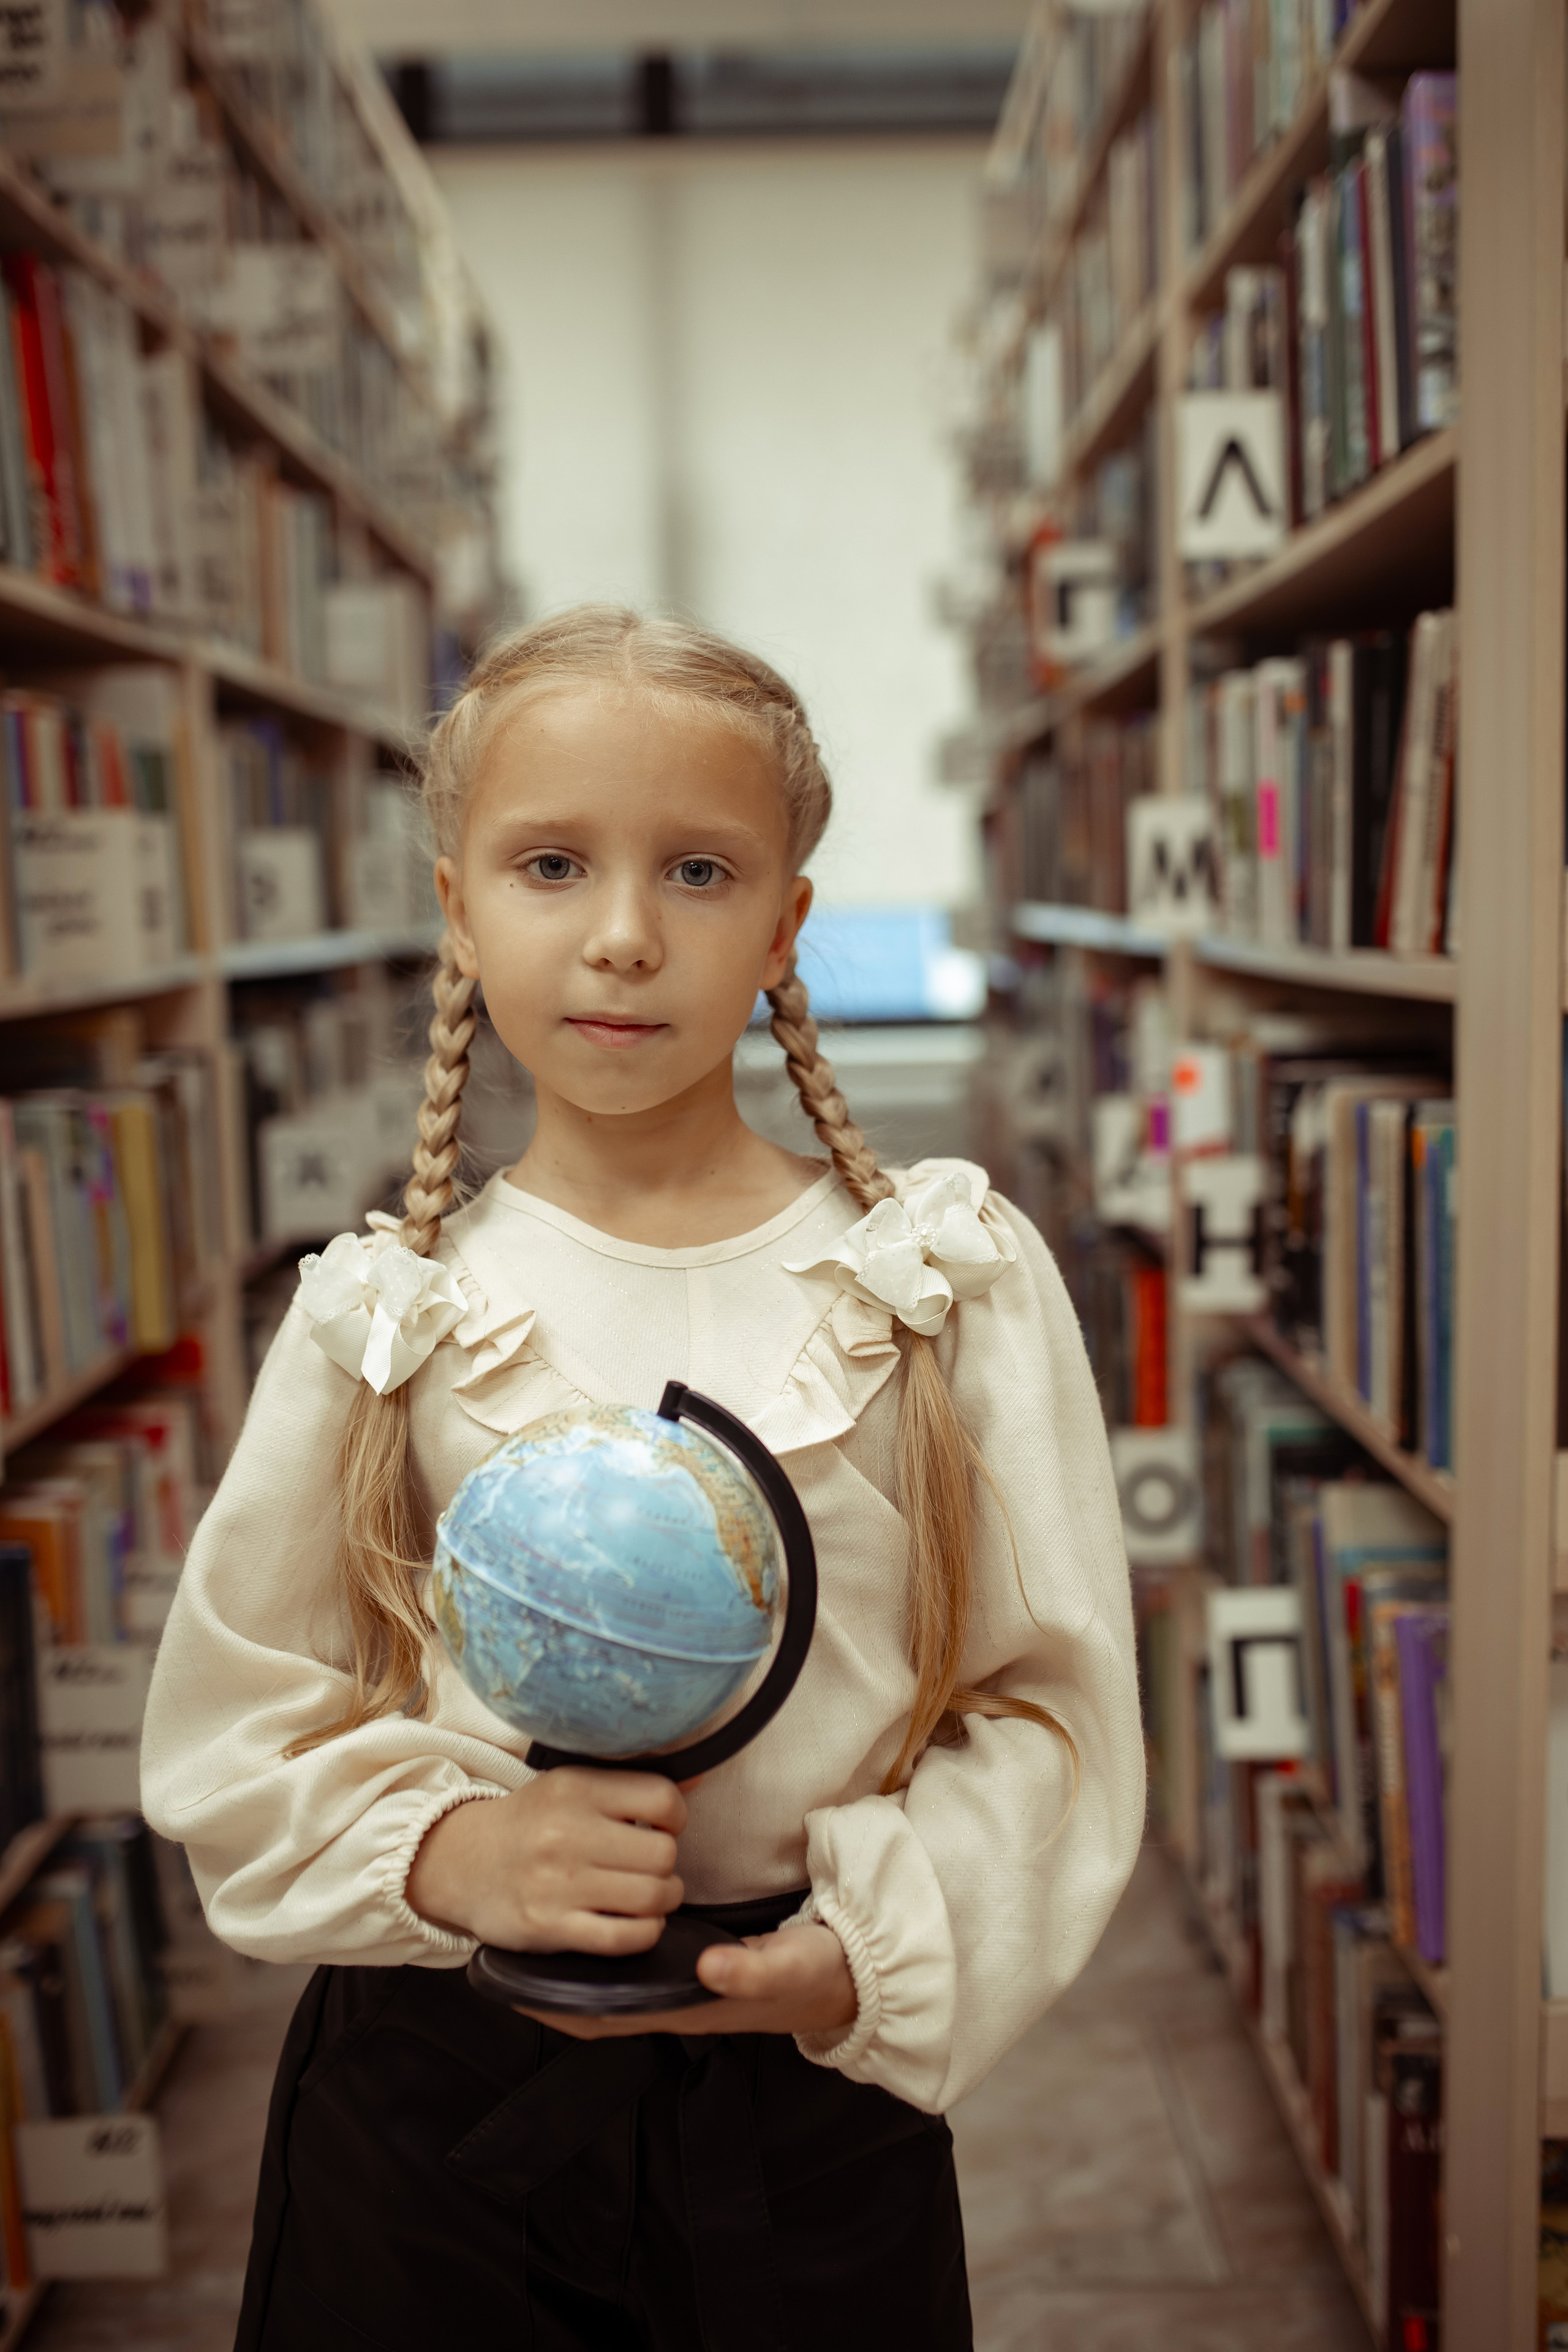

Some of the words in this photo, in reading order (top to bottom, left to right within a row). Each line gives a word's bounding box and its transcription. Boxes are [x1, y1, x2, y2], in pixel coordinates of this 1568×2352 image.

[1197, 437, 1273, 518] Л
[1191, 1203, 1264, 1278] Н
[1231, 1634, 1306, 1719] П
